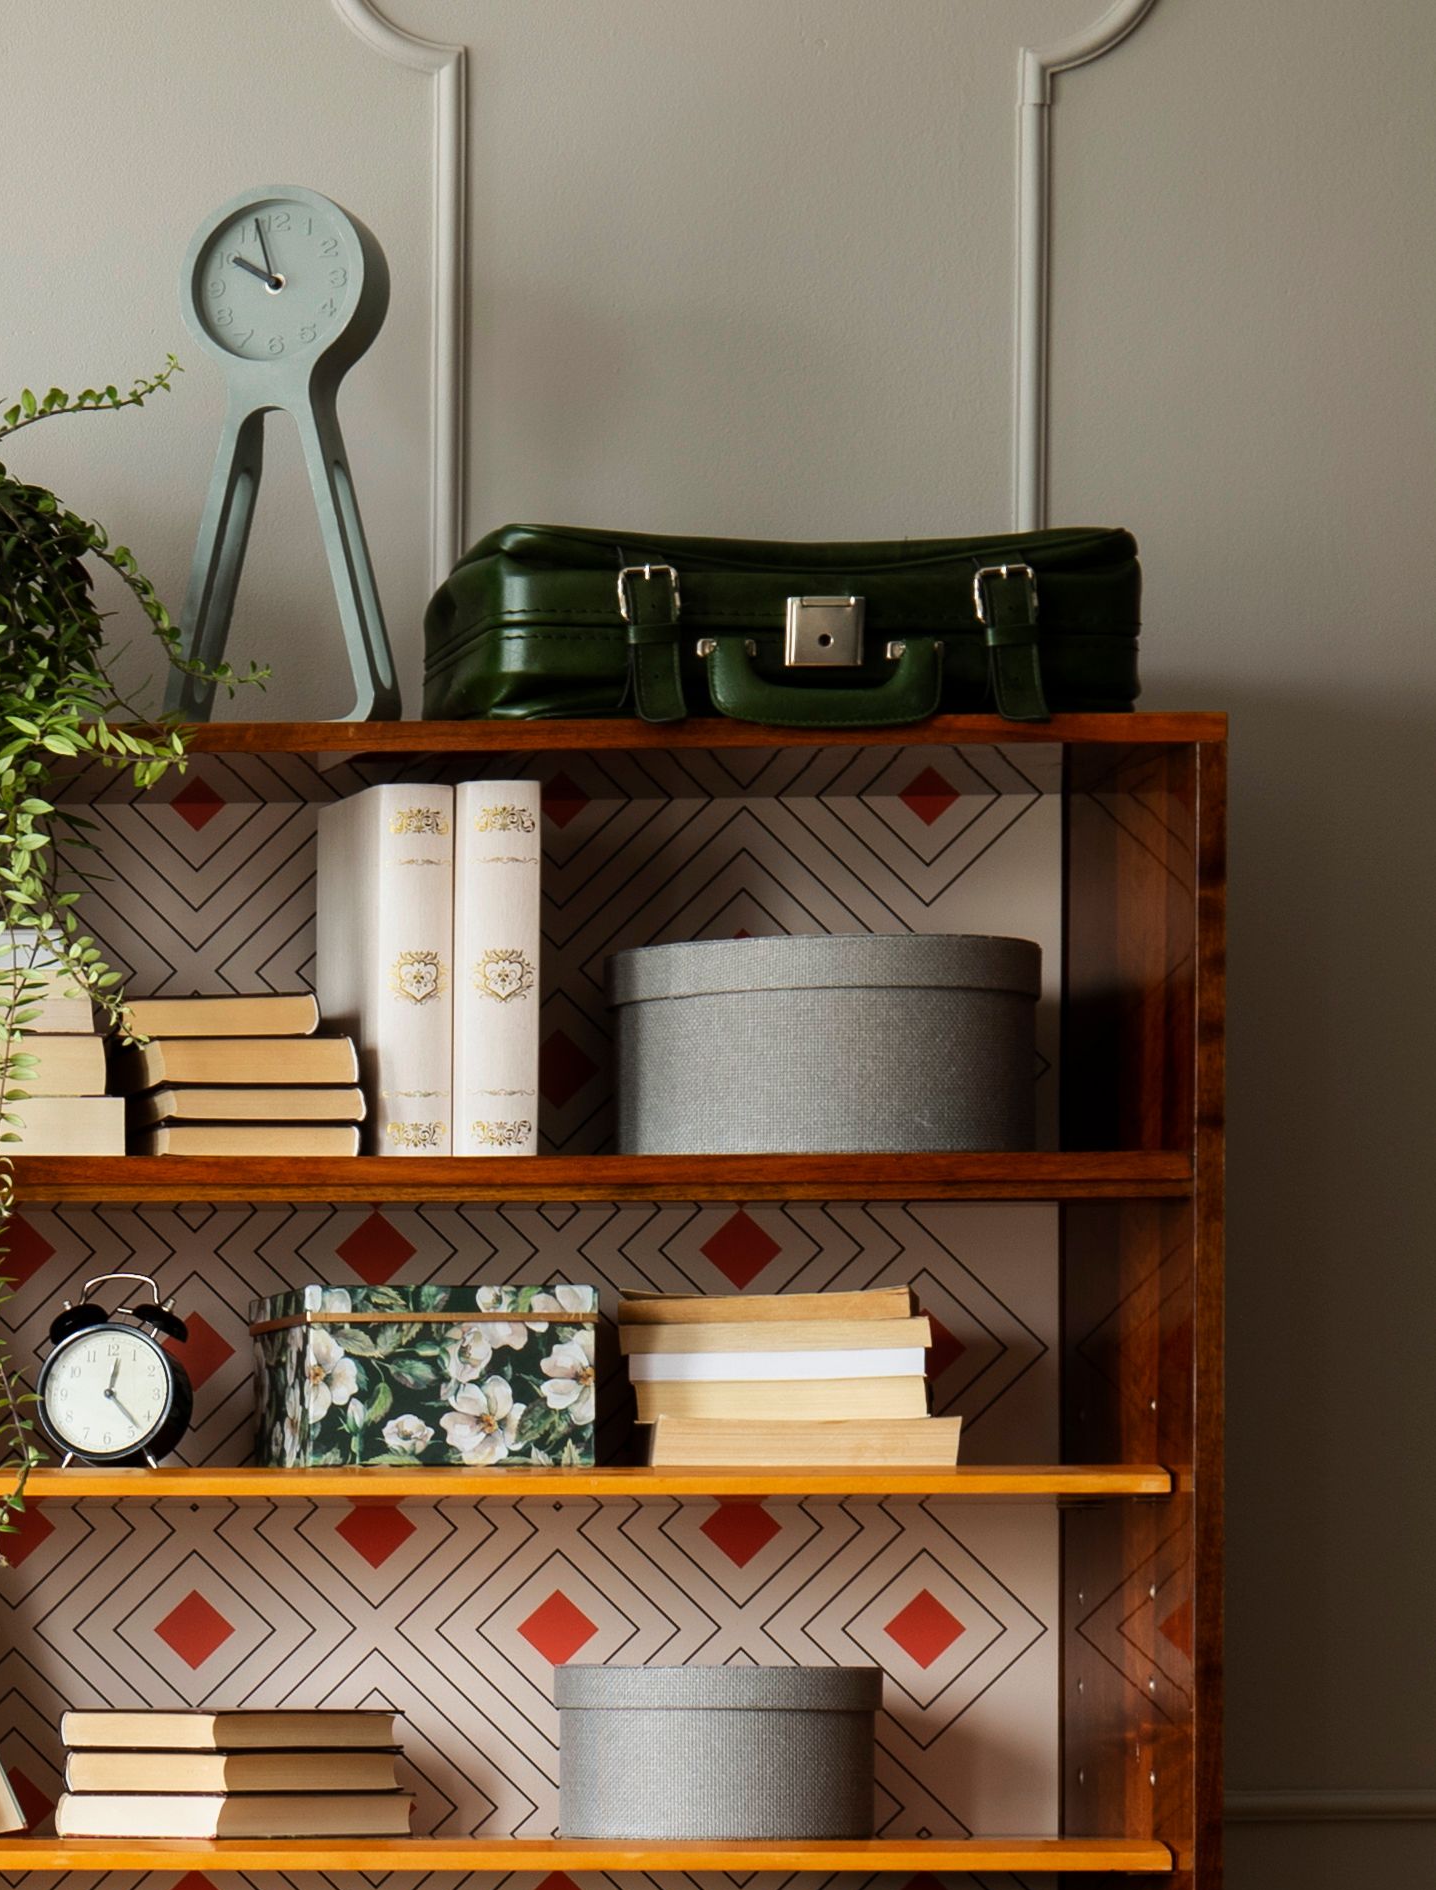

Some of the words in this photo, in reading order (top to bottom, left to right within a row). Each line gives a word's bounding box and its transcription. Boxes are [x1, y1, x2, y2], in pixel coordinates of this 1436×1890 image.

[264, 211, 292, 233] 12
[304, 217, 313, 236] 1
[240, 222, 259, 244] 11
[318, 237, 339, 258] 2
[215, 250, 242, 270] 10
[328, 266, 348, 289] 3
[208, 278, 227, 299] 9
[317, 297, 338, 317] 4
[216, 306, 234, 327] 8
[233, 329, 255, 349] 7
[298, 323, 318, 344] 5
[268, 335, 286, 355] 6
[86, 1350, 97, 1363] 11
[107, 1344, 120, 1356] 12
[132, 1350, 138, 1362] 1
[70, 1366, 82, 1378] 10
[147, 1365, 156, 1377] 2
[60, 1388, 68, 1401] 9
[152, 1387, 161, 1400] 3
[65, 1410, 74, 1423] 8
[143, 1410, 153, 1423] 4
[83, 1427, 91, 1440] 7
[103, 1432, 112, 1445] 6
[127, 1425, 136, 1439] 5
